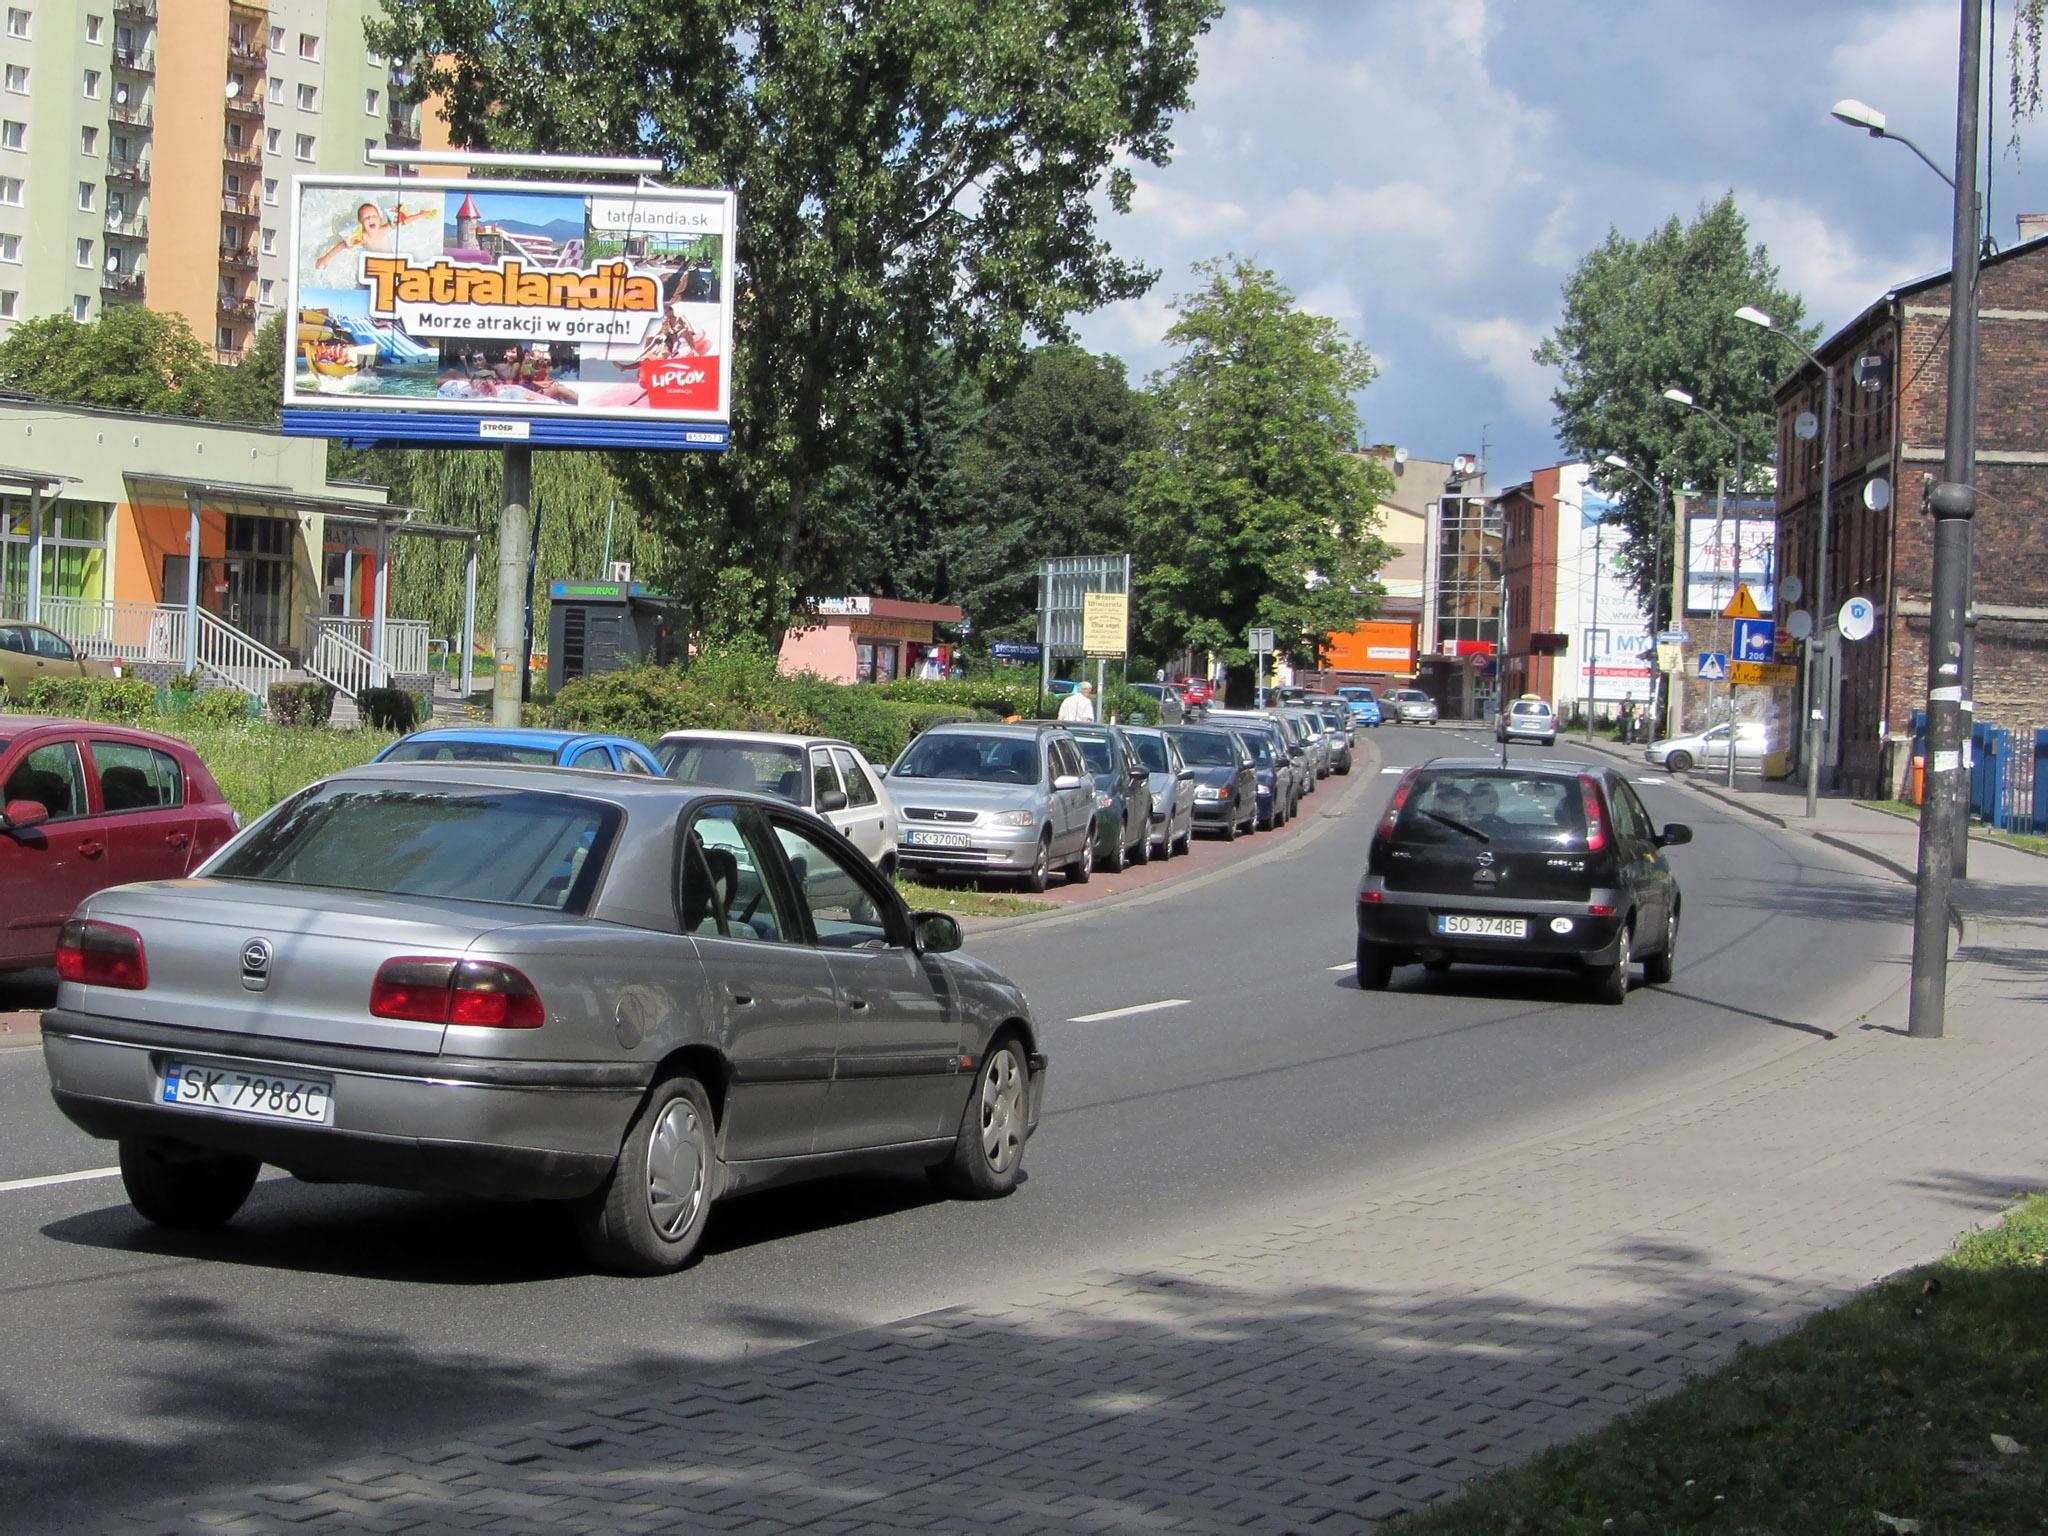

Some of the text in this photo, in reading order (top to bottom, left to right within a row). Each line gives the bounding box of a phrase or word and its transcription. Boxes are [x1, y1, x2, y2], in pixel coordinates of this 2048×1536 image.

[607, 209, 709, 226] tatralandia.sk
[364, 256, 659, 313] Tatralandia
[418, 312, 631, 336] Morze atrakcji w górach!
[596, 586, 619, 596] RUCH
[1748, 652, 1765, 660] 200
[914, 833, 965, 846] SK 3700N
[1447, 916, 1470, 932] SO
[1475, 917, 1523, 936] 3748E
[1555, 921, 1568, 930] PL
[165, 1084, 177, 1095] PL
[182, 1069, 324, 1117] SK 7986C
